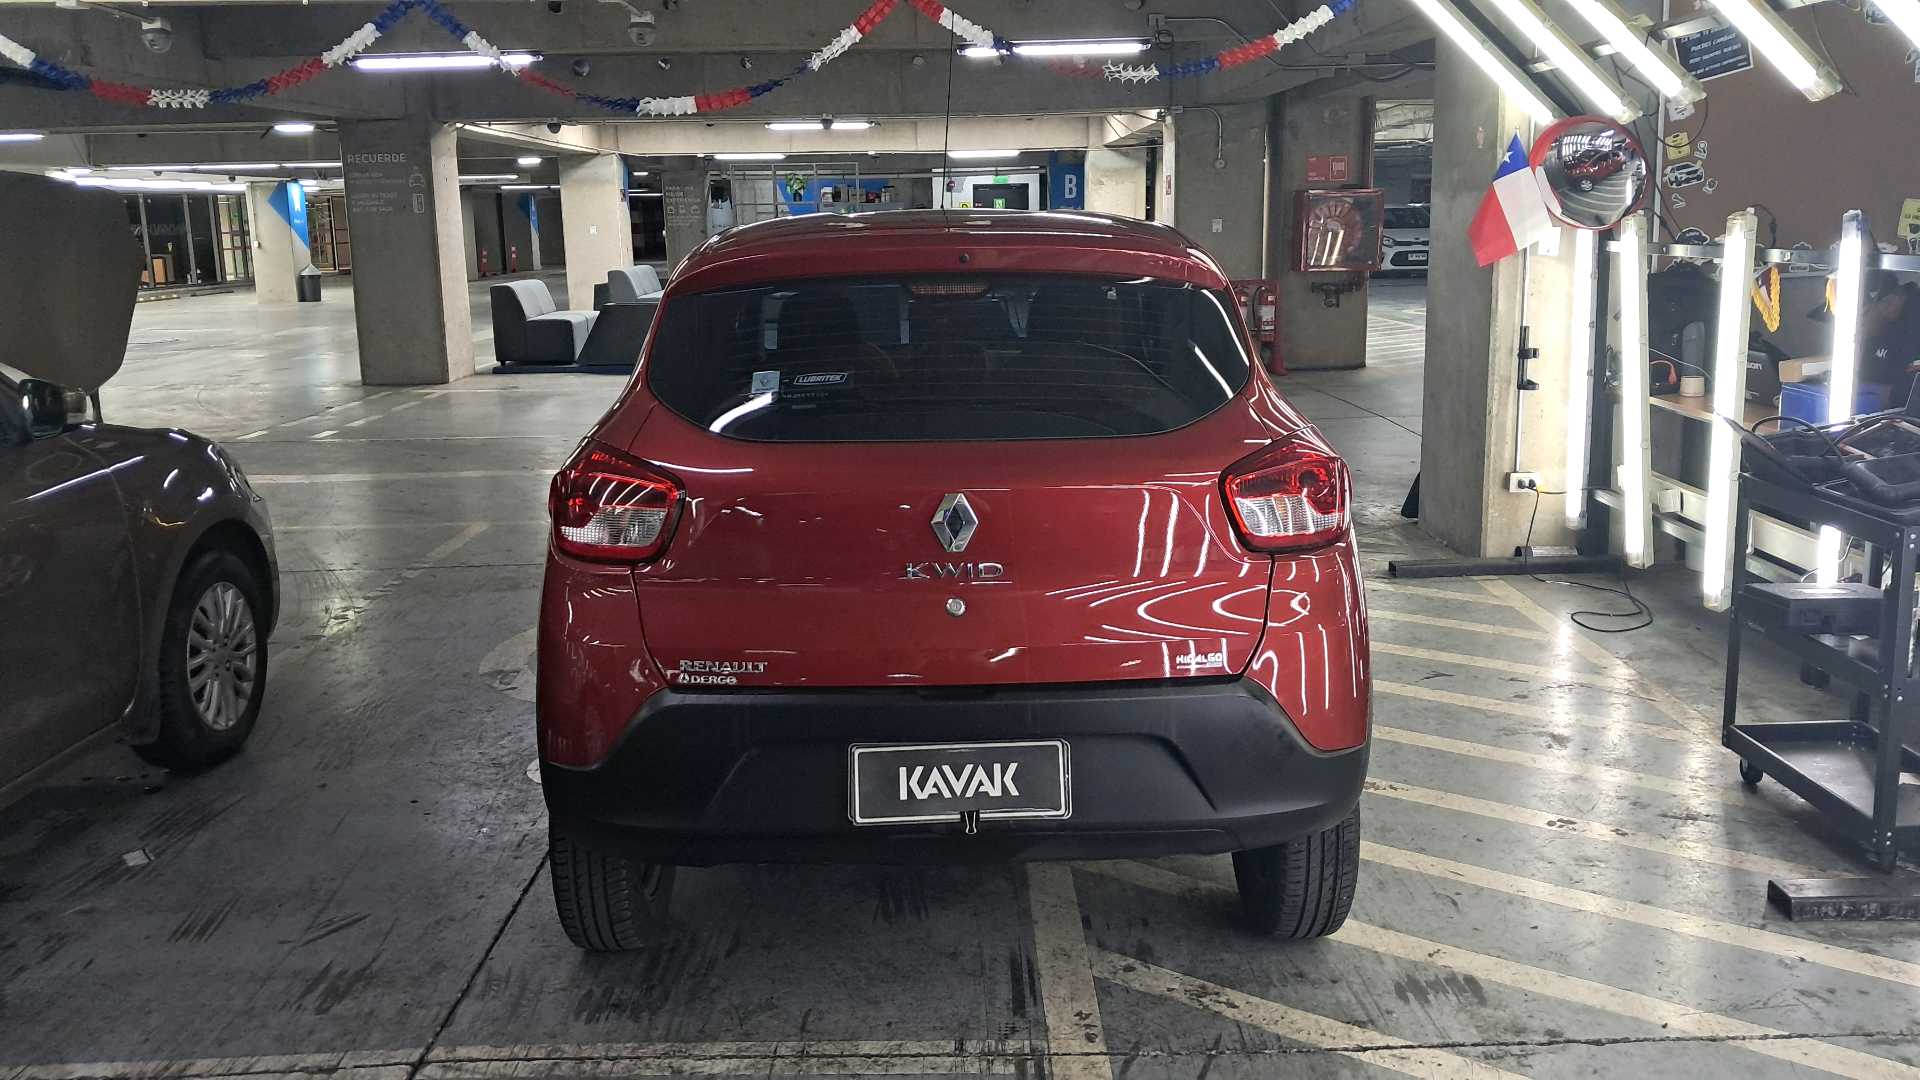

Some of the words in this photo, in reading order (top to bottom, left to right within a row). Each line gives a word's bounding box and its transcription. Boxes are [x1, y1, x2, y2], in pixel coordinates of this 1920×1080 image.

[347, 153, 408, 164] RECUERDE
[1064, 174, 1077, 199] B
[906, 562, 1004, 579] KWID
[1176, 652, 1223, 664] HIDALGO
[680, 660, 768, 673] RENAULT
[899, 762, 1020, 800] KAVAK
